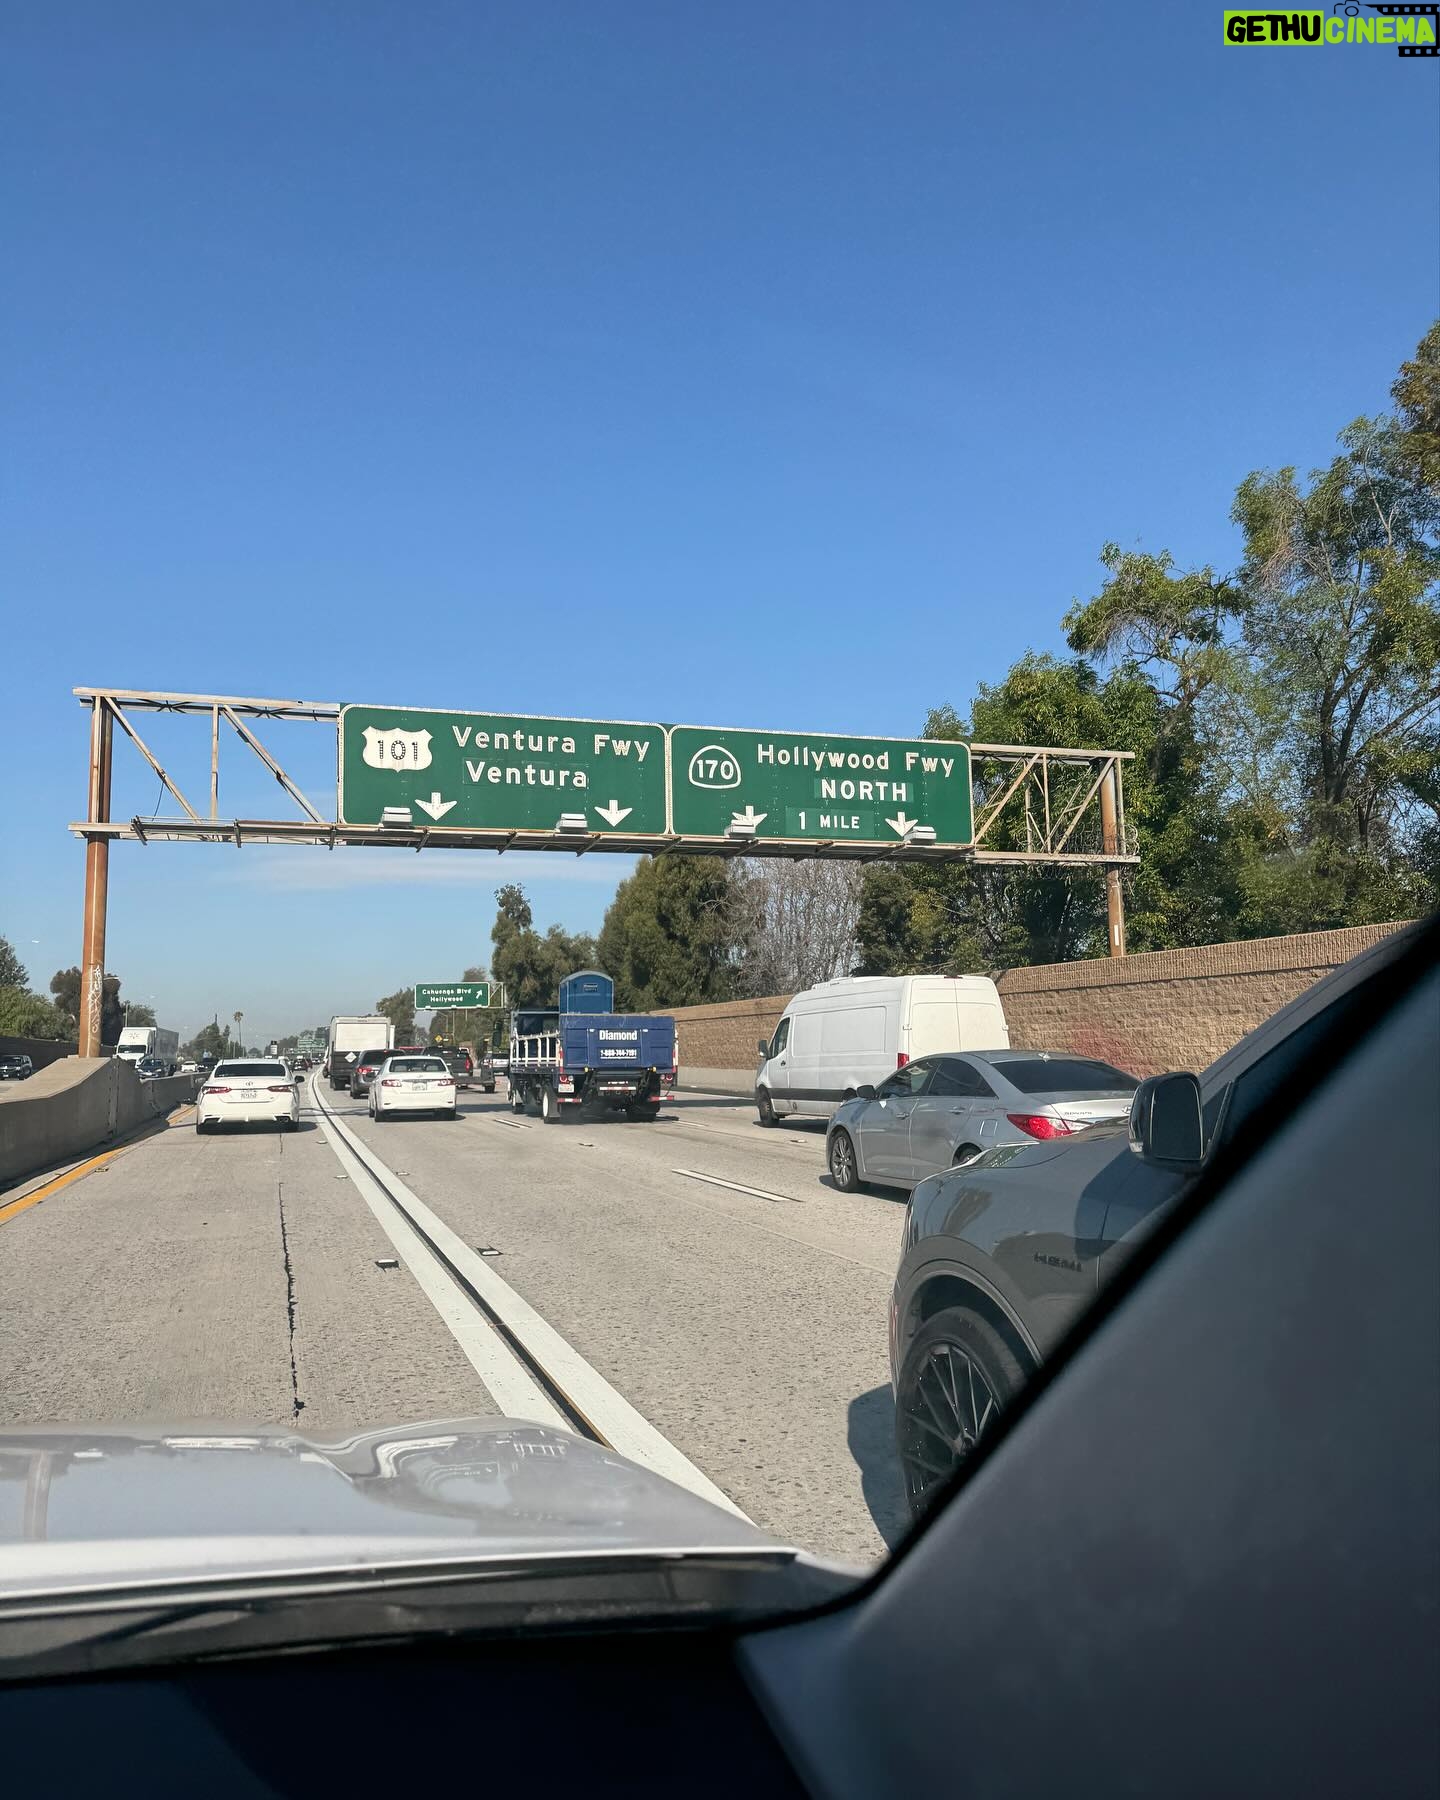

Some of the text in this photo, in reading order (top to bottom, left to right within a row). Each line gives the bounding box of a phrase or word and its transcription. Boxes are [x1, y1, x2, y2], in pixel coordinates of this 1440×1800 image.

[377, 739, 419, 762] 101
[452, 725, 650, 762] Ventura Fwy
[696, 759, 735, 781] 170
[757, 743, 955, 778] Hollywood Fwy
[465, 760, 587, 789] Ventura
[821, 778, 907, 802] NORTH
[798, 811, 860, 830] 1 MILE
[599, 1029, 638, 1041] Diamond
